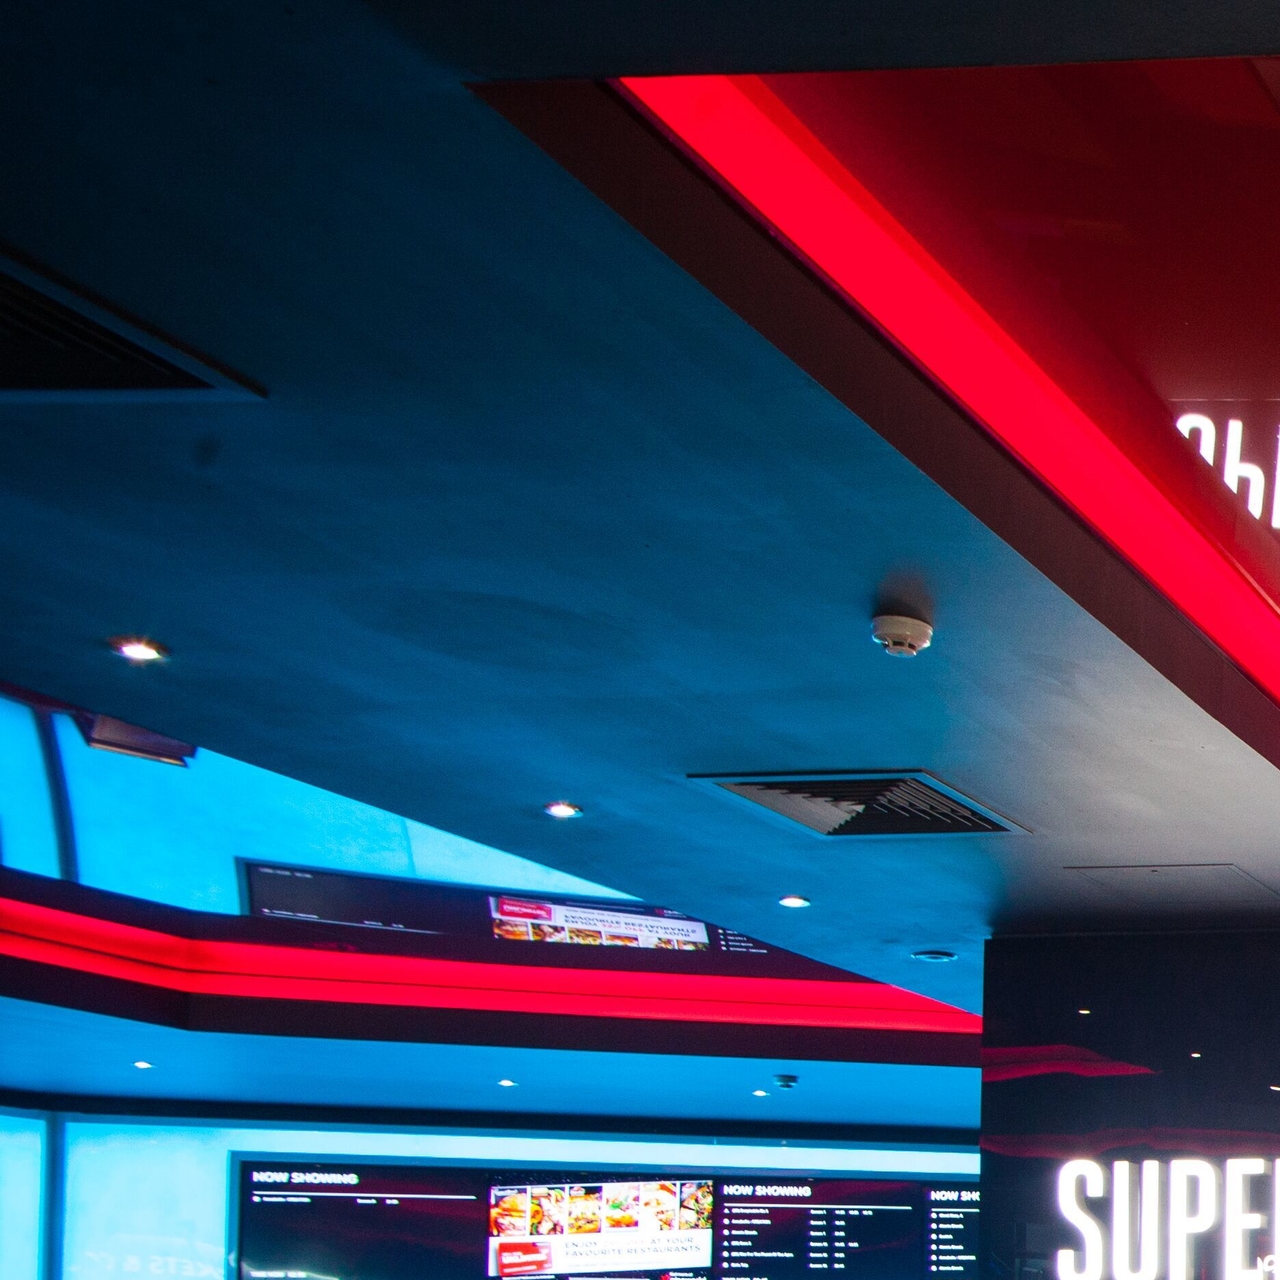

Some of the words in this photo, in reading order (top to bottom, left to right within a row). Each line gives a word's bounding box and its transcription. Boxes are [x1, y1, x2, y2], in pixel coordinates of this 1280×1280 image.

[252, 1172, 290, 1183] NOW
[291, 1172, 359, 1185] SHOWING
[723, 1185, 754, 1196] NOW
[755, 1185, 812, 1197] SHOWING
[931, 1191, 959, 1201] NOW
